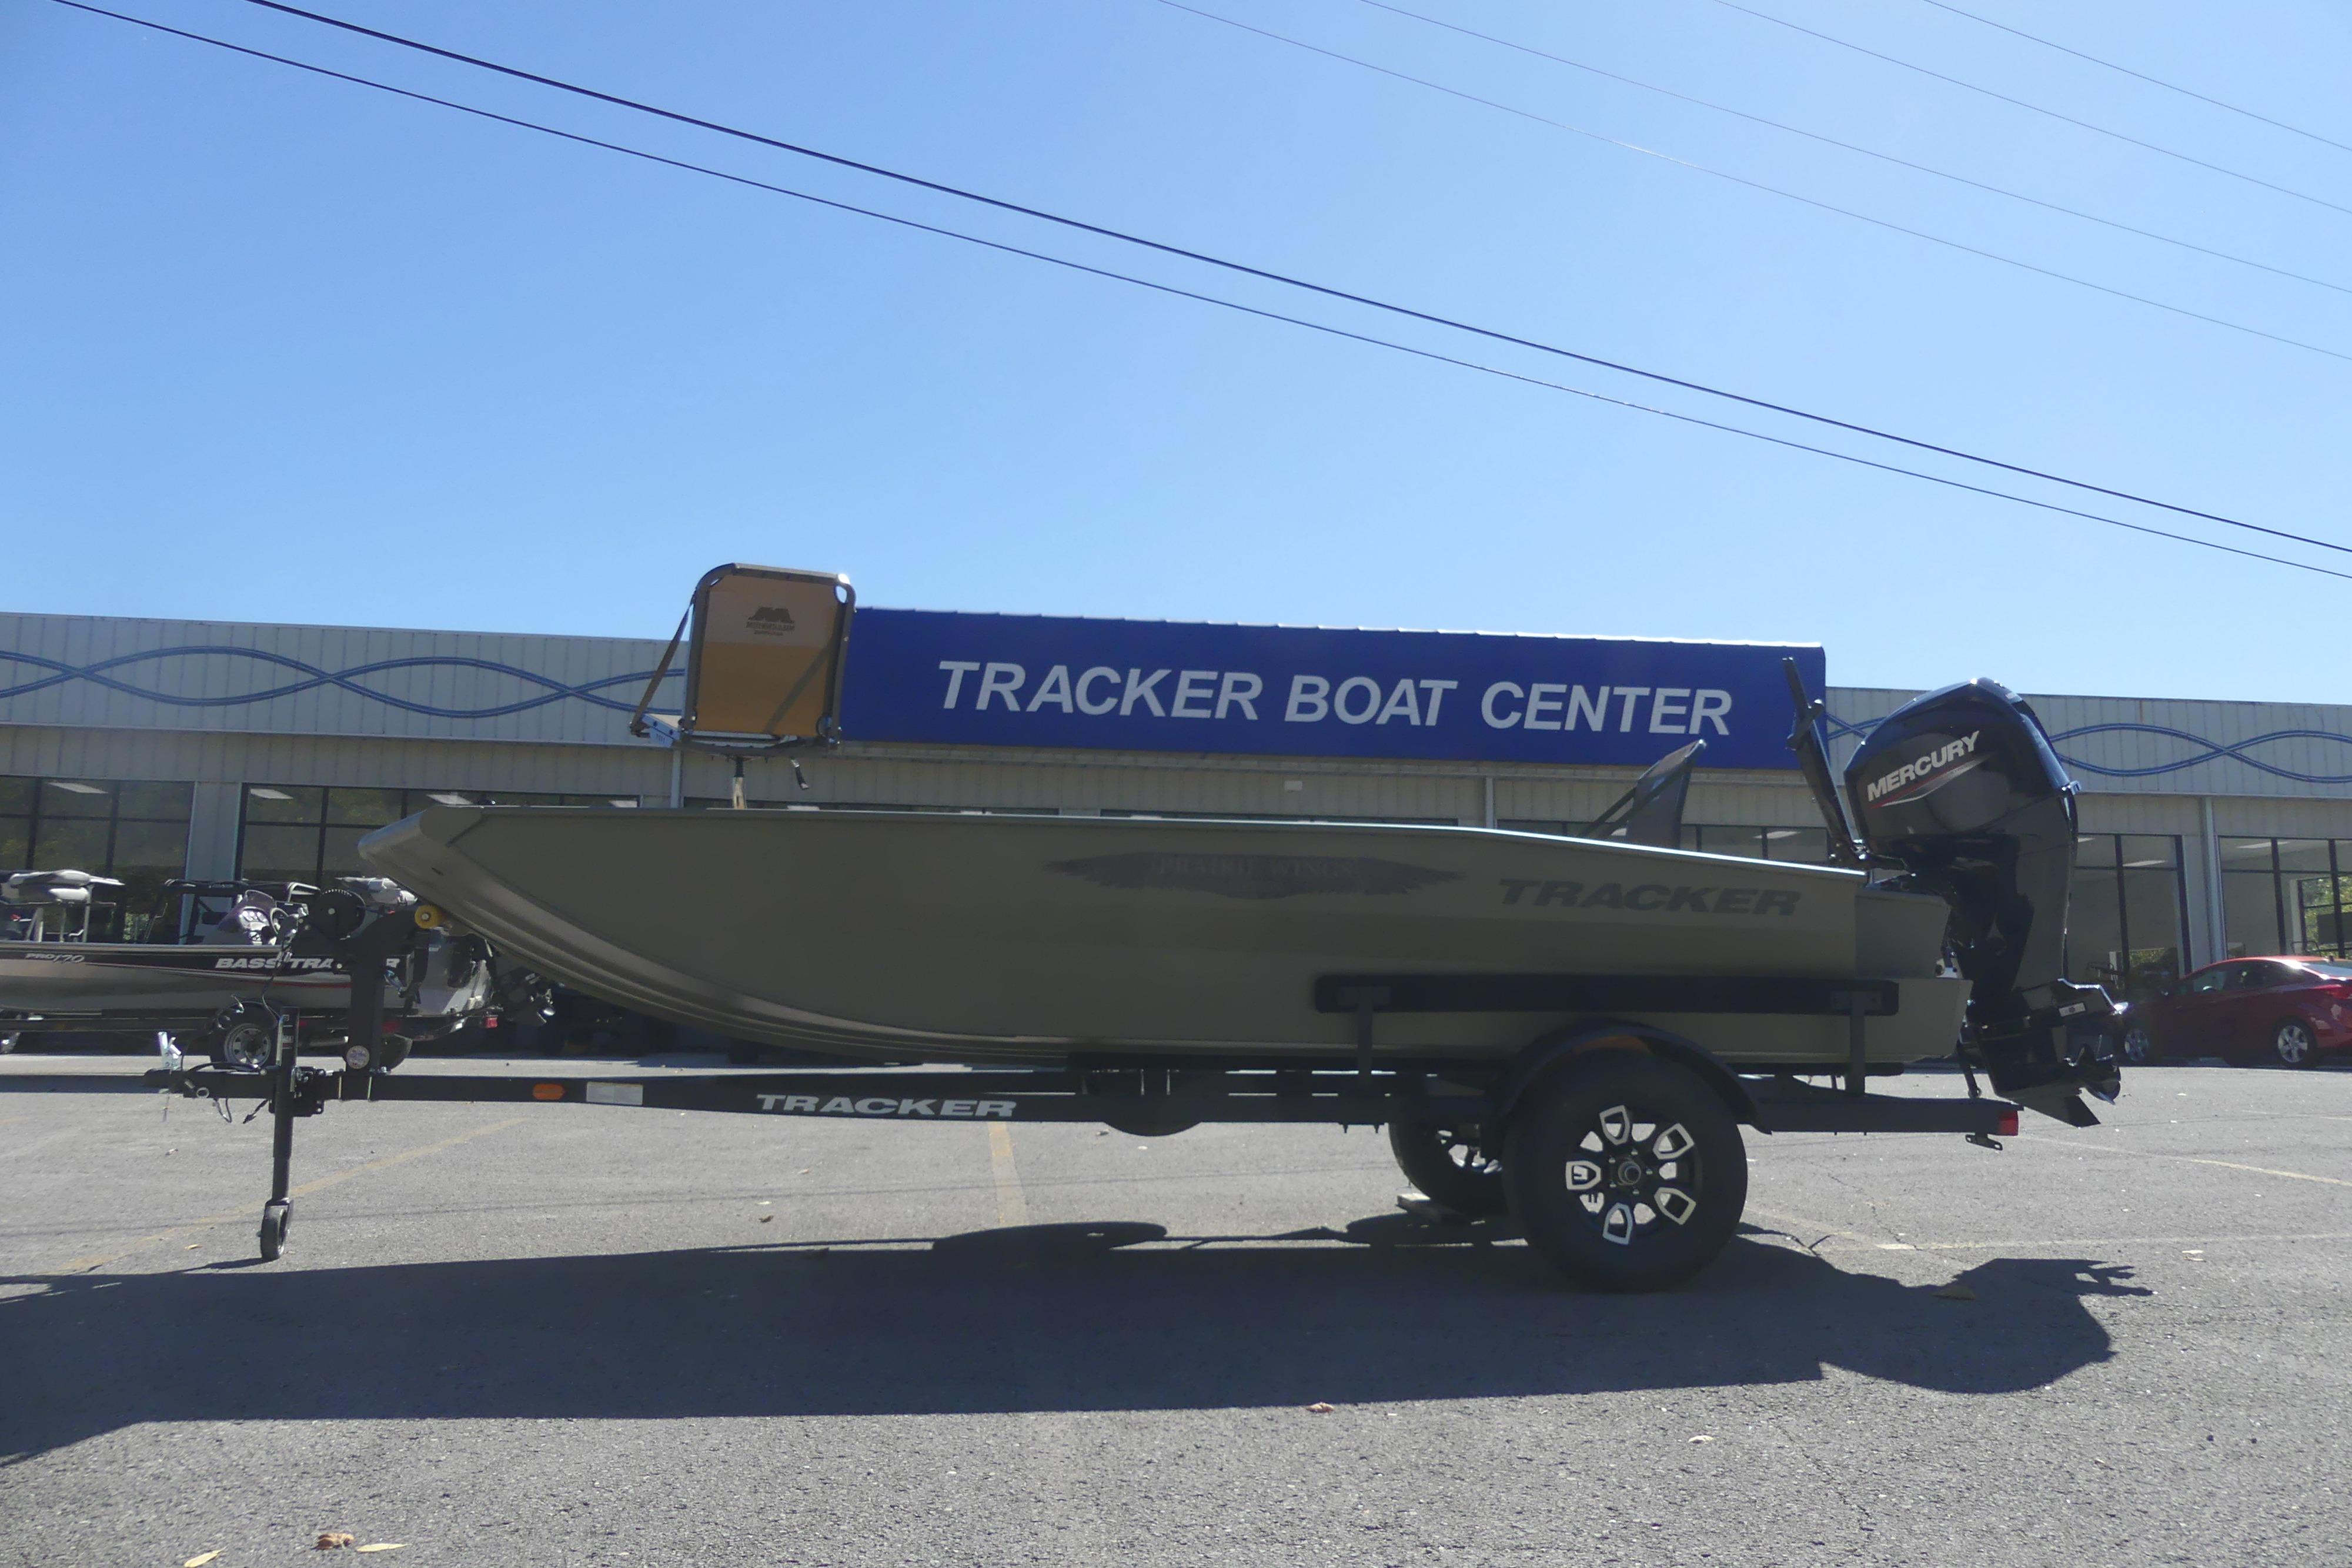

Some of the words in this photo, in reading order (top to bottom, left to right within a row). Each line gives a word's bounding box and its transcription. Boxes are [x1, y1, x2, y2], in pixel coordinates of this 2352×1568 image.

[939, 660, 1263, 721] TRACKER
[1284, 674, 1458, 726] BOAT
[1481, 682, 1733, 735] CENTER
[1866, 730, 1980, 802] MERCURY
[1499, 877, 1802, 916] TRACKER
[215, 958, 281, 969] BASS
[288, 958, 400, 969] TRAR
[757, 1094, 1017, 1118] TRACKER
